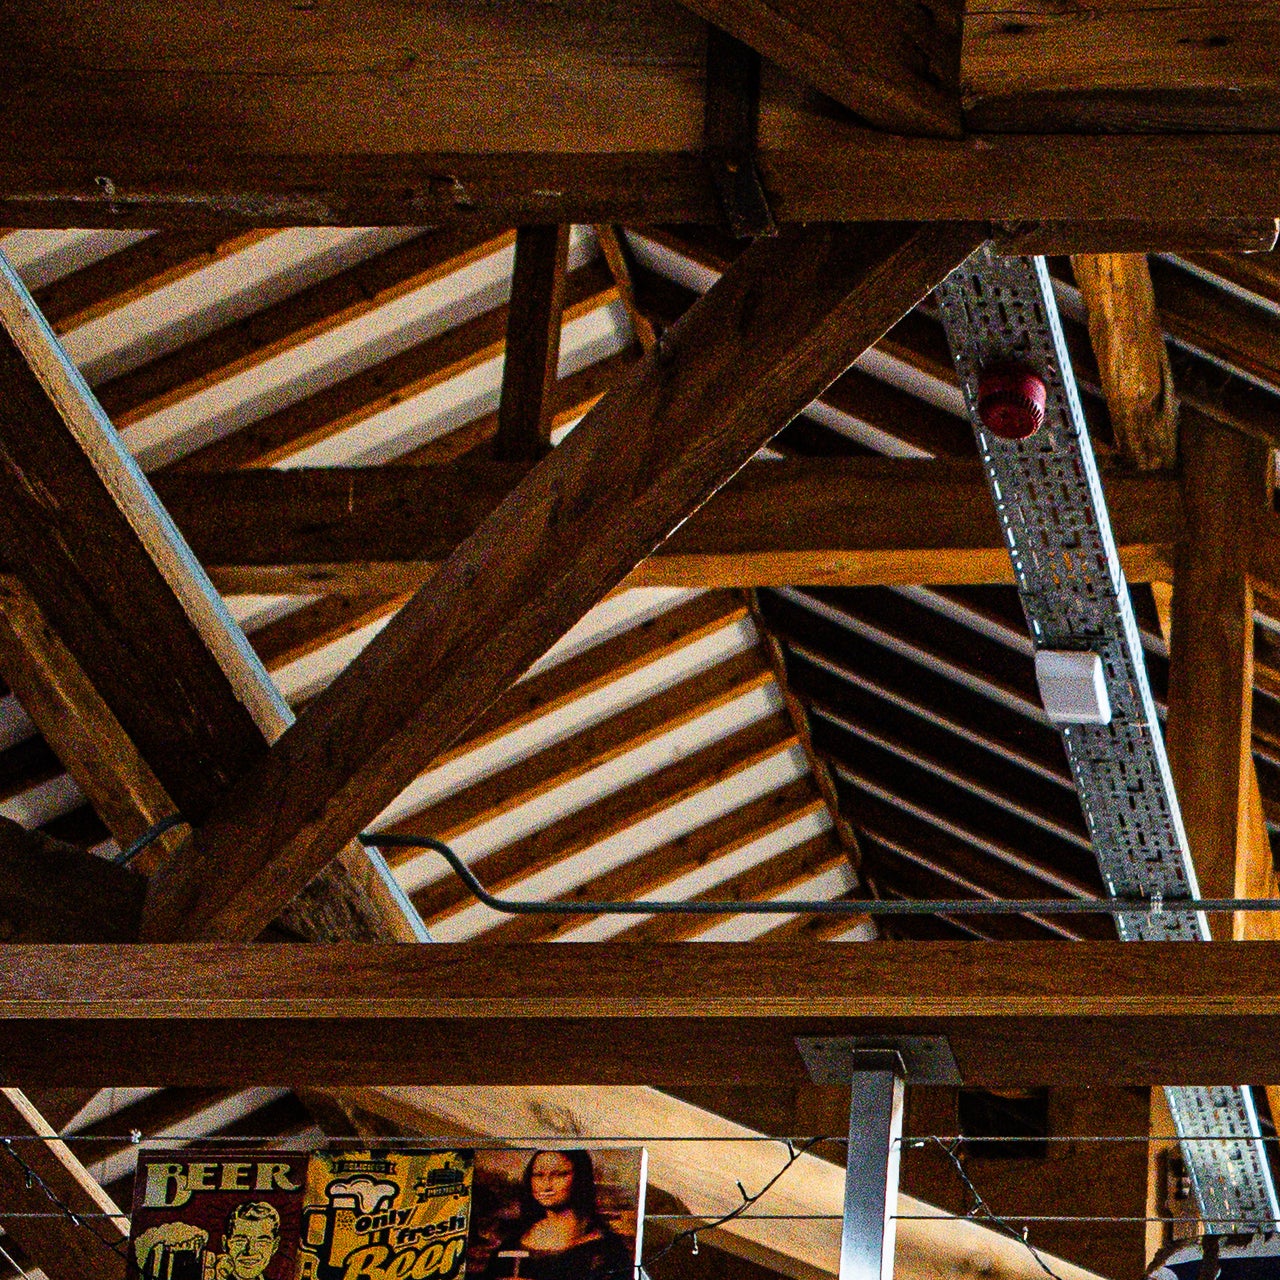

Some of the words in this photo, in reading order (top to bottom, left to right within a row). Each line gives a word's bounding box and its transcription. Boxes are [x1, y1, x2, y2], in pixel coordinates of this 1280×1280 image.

[142, 1161, 304, 1209] BEER
[356, 1207, 412, 1233] only
[396, 1214, 466, 1244] fresh
